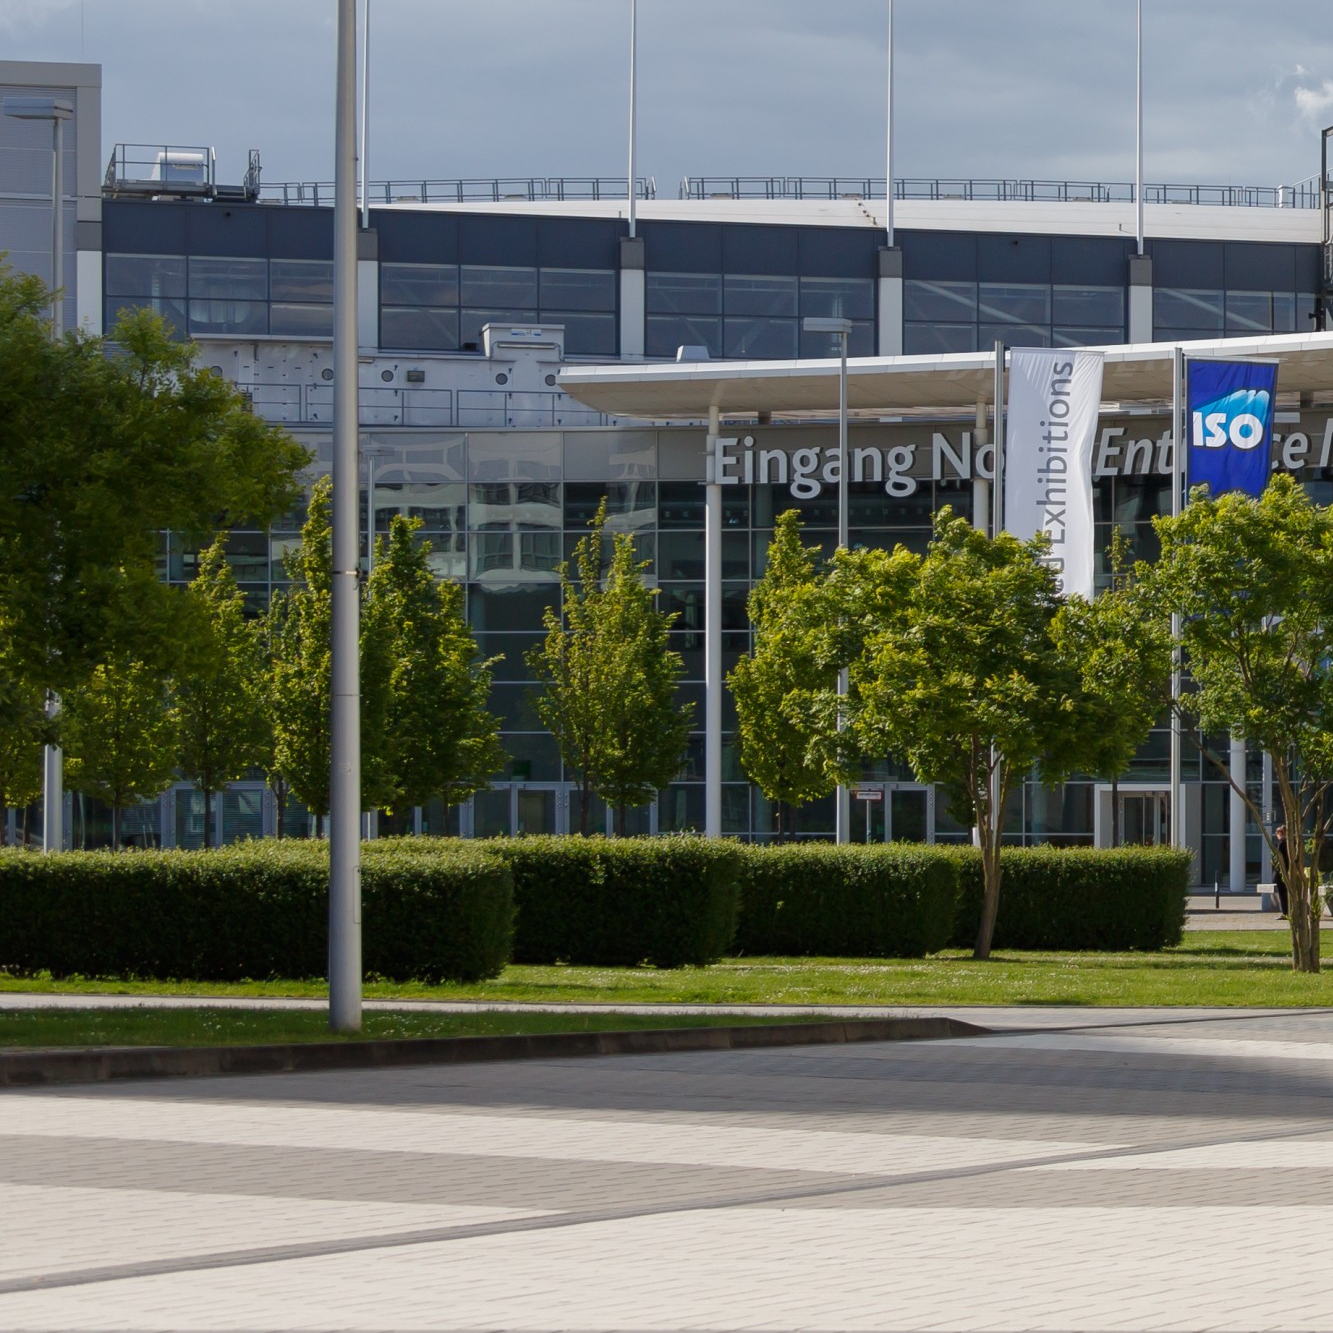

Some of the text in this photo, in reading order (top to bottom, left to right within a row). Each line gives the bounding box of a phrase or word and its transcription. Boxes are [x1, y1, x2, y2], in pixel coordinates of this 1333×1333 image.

[1036, 361, 1073, 544] Exhibitions
[1193, 411, 1264, 450] ISO
[715, 436, 918, 499] Eingang
